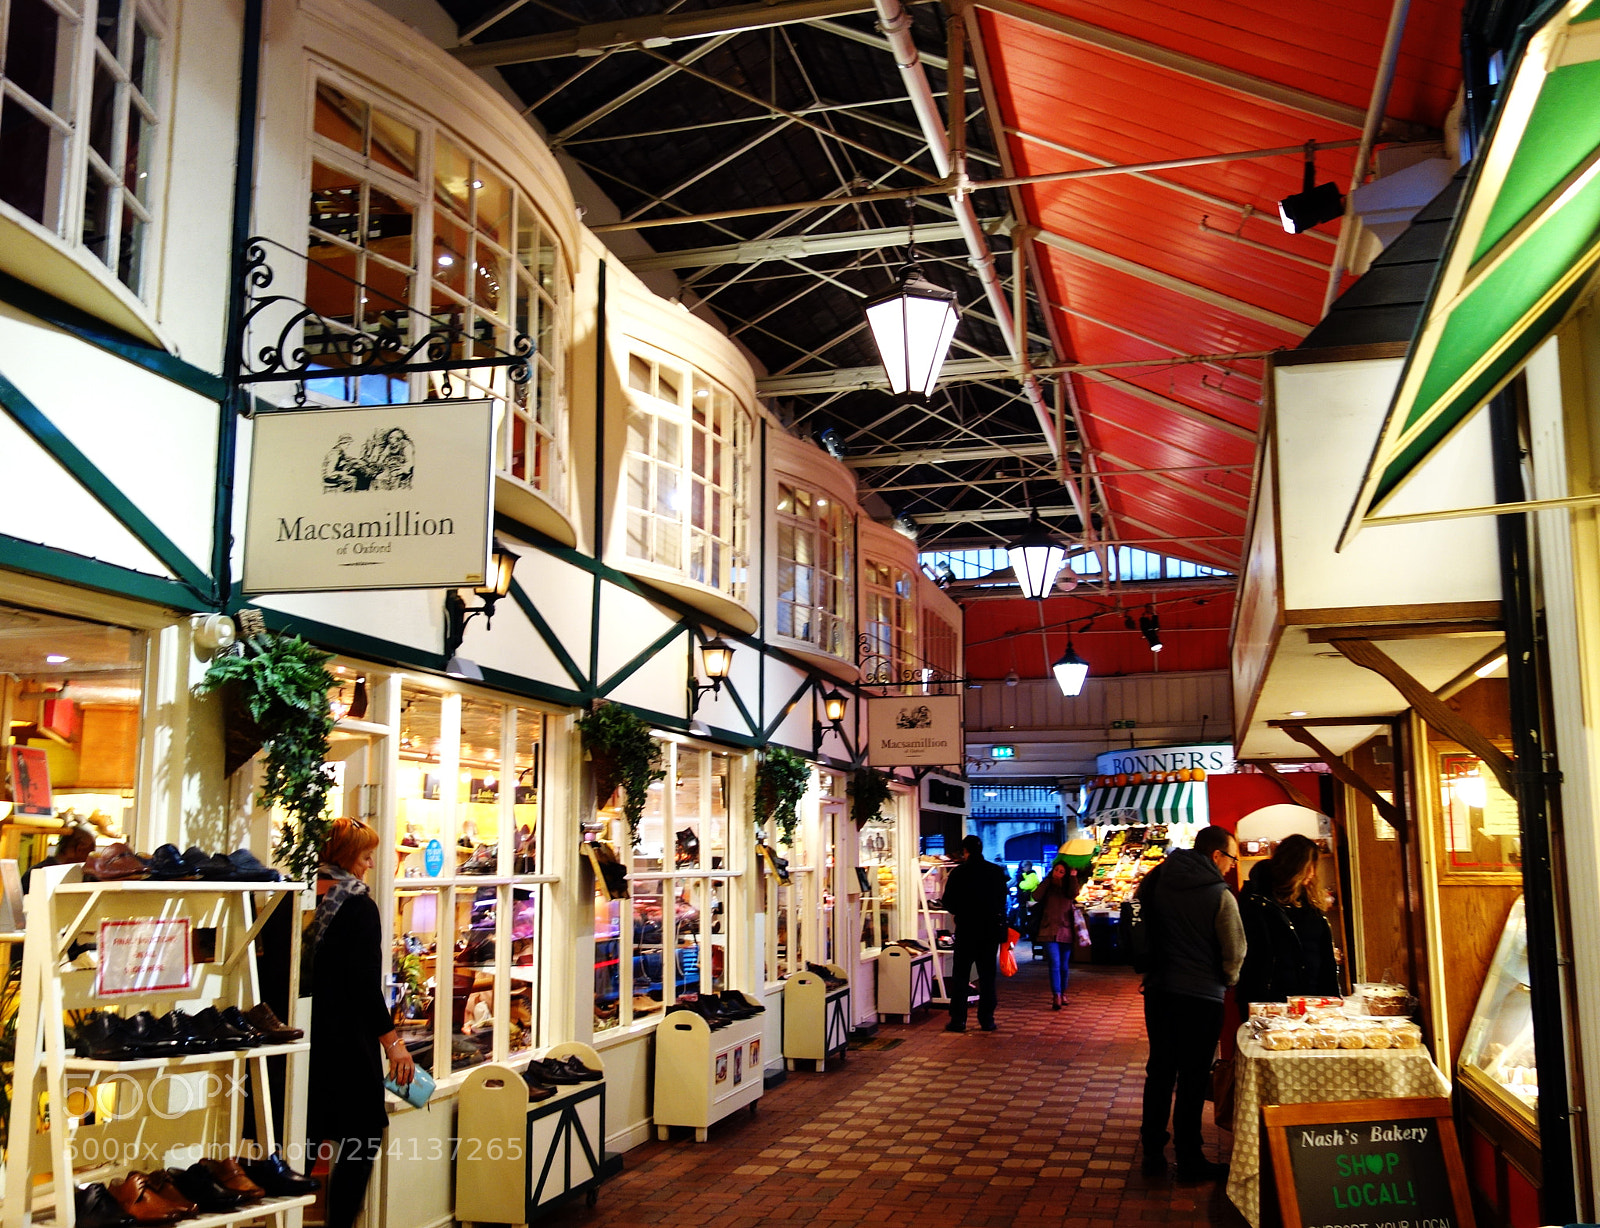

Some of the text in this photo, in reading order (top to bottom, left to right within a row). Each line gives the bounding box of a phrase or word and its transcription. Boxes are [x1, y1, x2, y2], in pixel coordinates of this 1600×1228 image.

[276, 511, 455, 542] Macsamillion
[336, 542, 392, 555] of Oxford
[880, 738, 948, 749] Macsamillion
[1112, 751, 1223, 776] BONNERS
[1301, 1124, 1428, 1148] Nash's Bakery
[1332, 1180, 1417, 1209] LOCAL!
